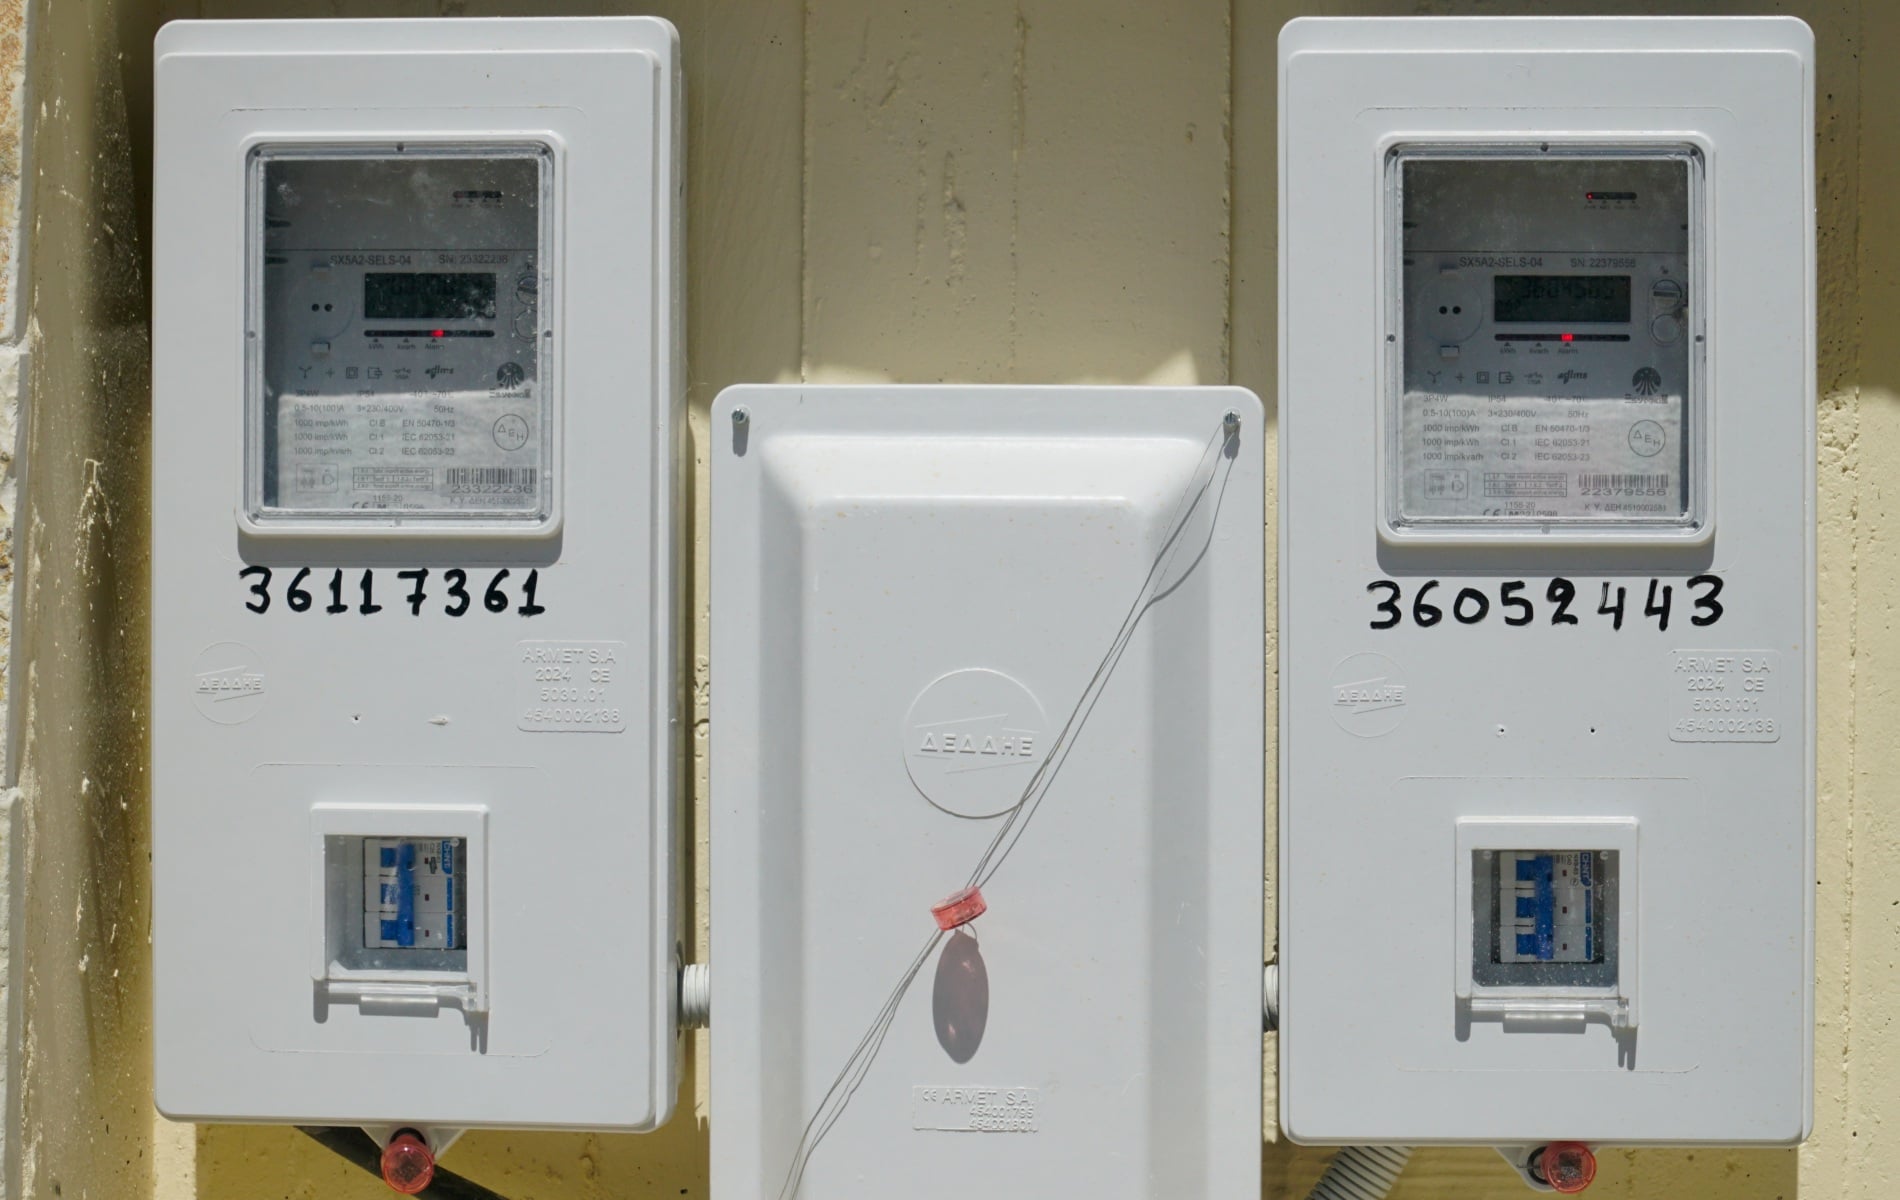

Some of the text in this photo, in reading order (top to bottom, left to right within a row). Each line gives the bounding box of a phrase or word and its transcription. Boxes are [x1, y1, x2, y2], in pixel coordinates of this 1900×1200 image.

[330, 254, 412, 266] SX5A2-SELS-04
[1459, 256, 1543, 268] SX5A2-SELS-04
[1423, 424, 1443, 433] 1000
[1422, 438, 1443, 447] 1000
[1535, 438, 1551, 447] IEC
[1422, 452, 1443, 461] 1000
[1534, 452, 1550, 461] IEC
[451, 485, 534, 494] 23322236
[1581, 488, 1667, 496] 22379556
[239, 566, 546, 616] 36117361
[1366, 574, 1724, 632] 36052443
[522, 648, 584, 664] ARMET
[1674, 657, 1735, 673] ARMET
[536, 666, 610, 683] 2024 CE
[1688, 676, 1764, 692] 2024 CE
[942, 1089, 998, 1105] ARMET
